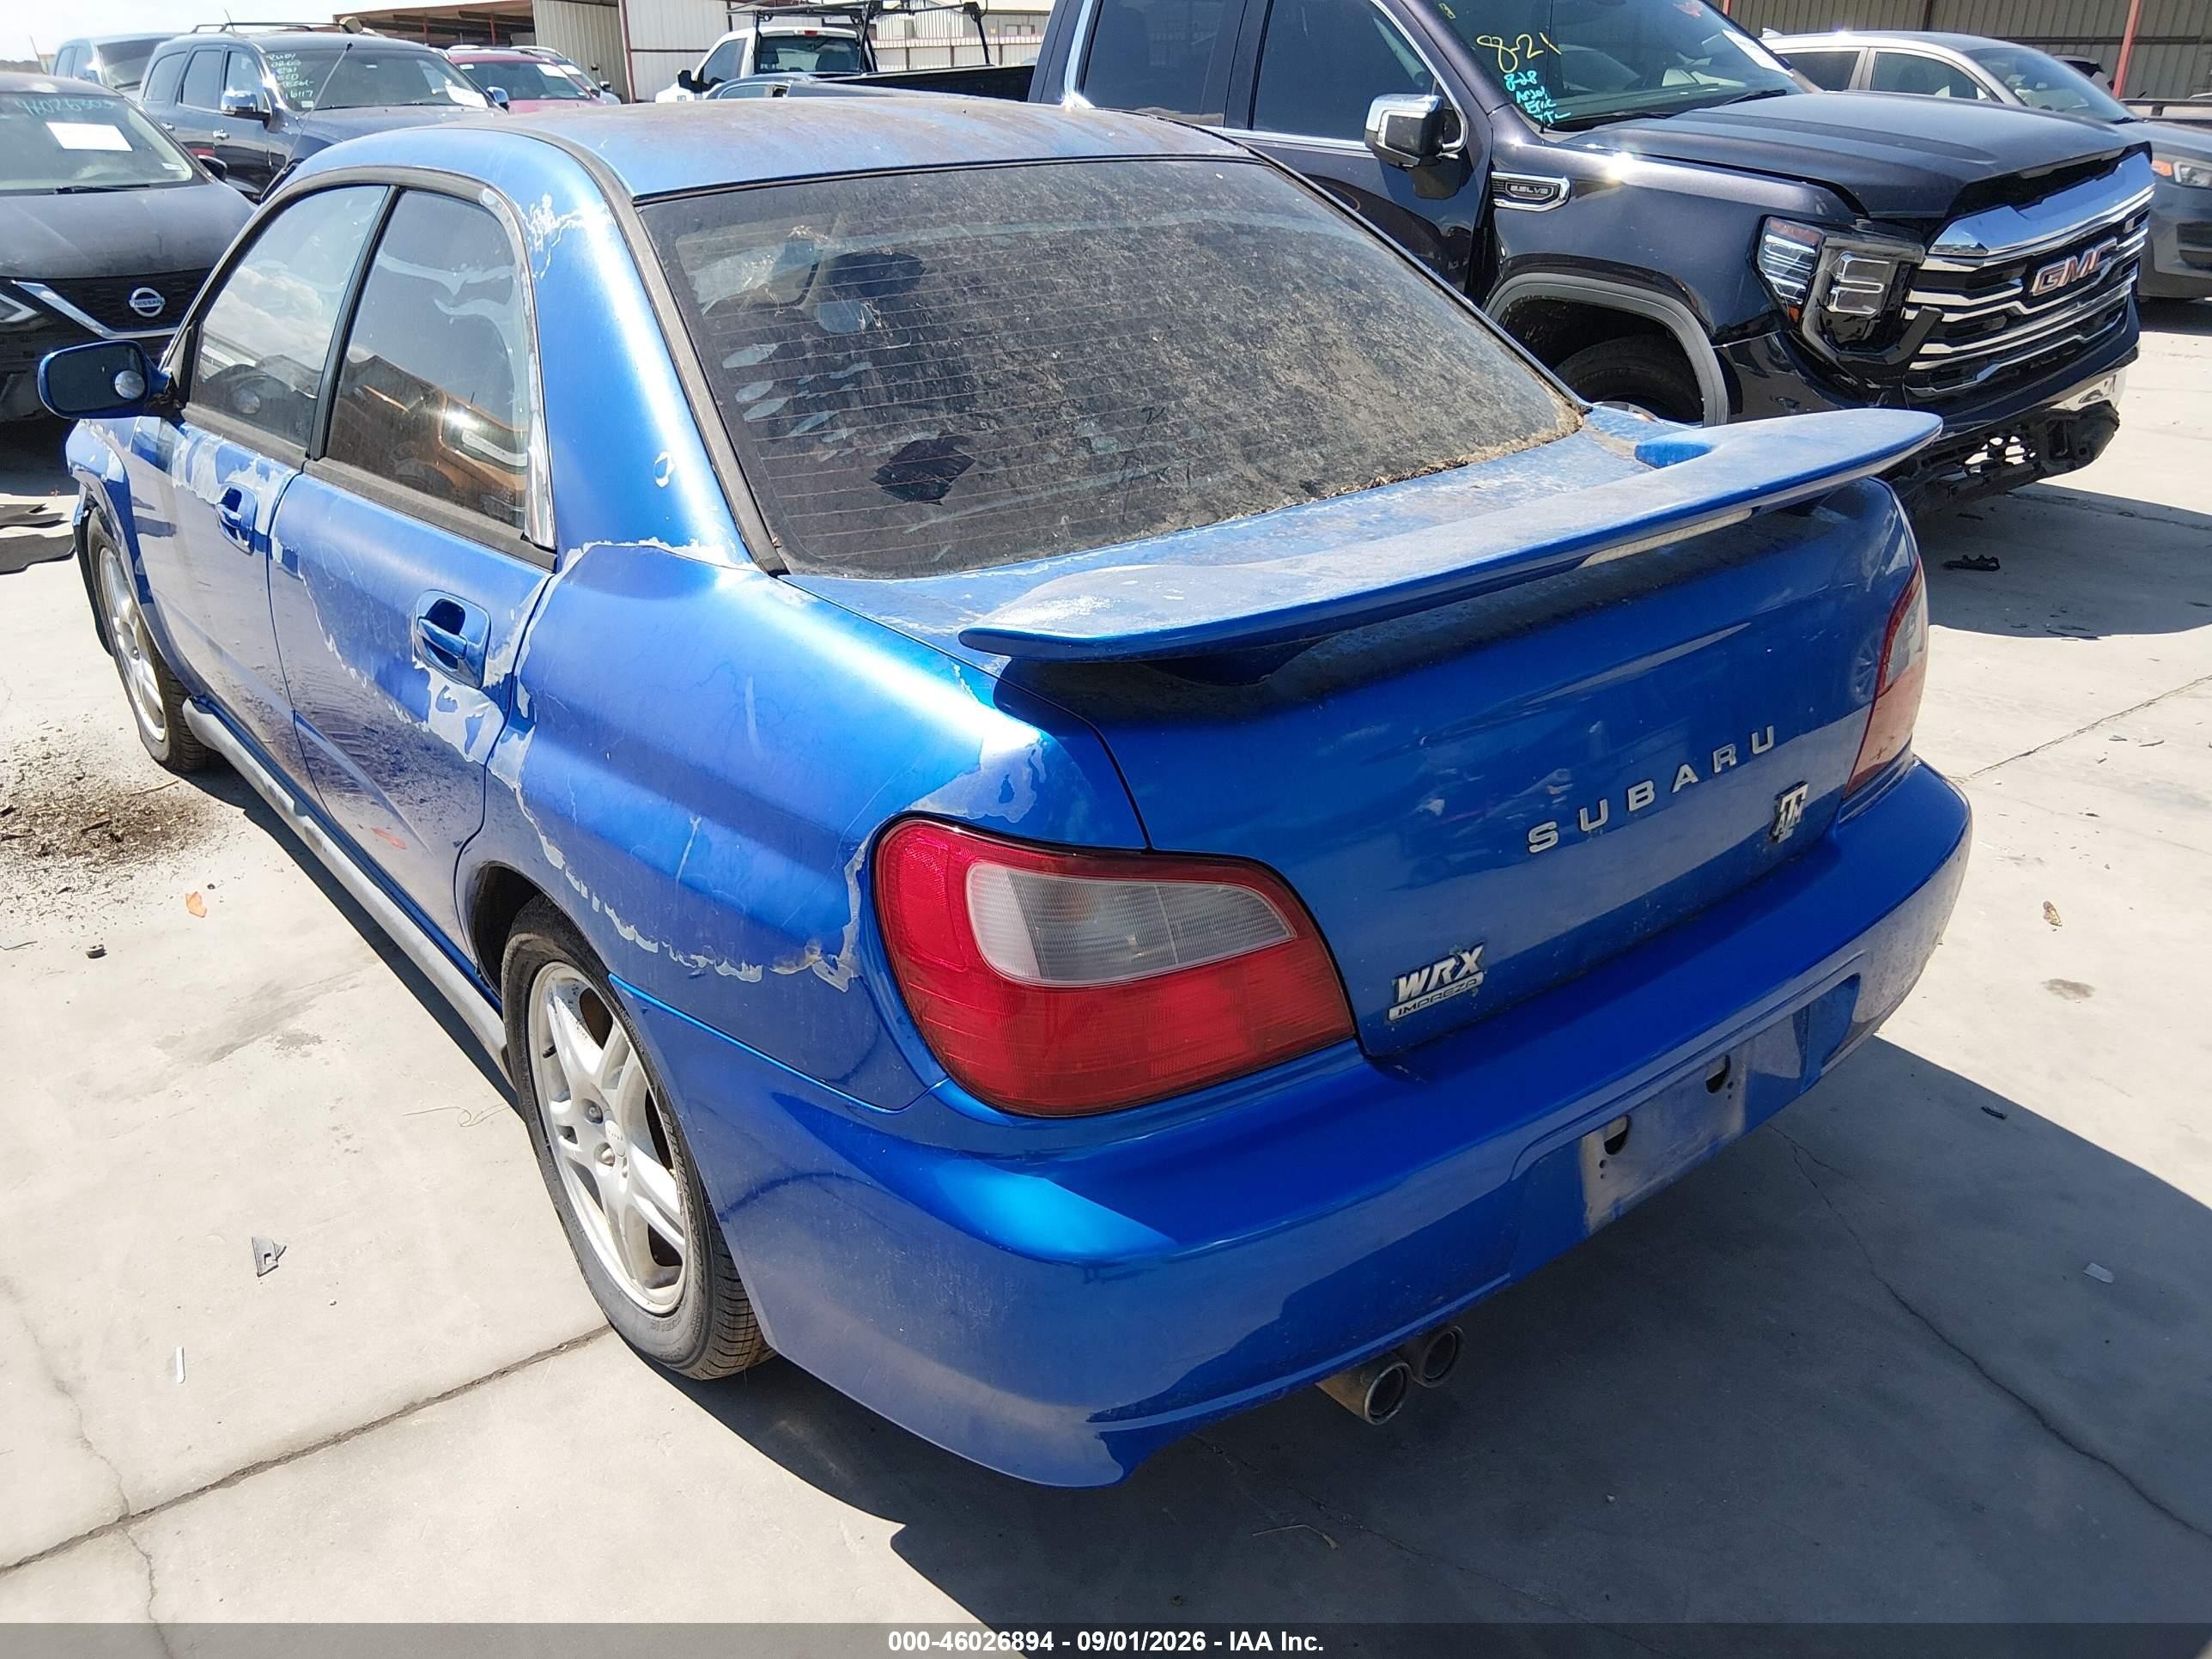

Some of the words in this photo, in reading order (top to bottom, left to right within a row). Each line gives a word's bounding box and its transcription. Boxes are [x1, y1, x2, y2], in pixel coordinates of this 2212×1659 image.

[1476, 32, 1562, 74] 8-21
[2031, 237, 2118, 296] GMC
[1528, 726, 1775, 854] SUBARU
[1396, 945, 1485, 1004] WRX
[1397, 978, 1478, 1017] IMPREZA
